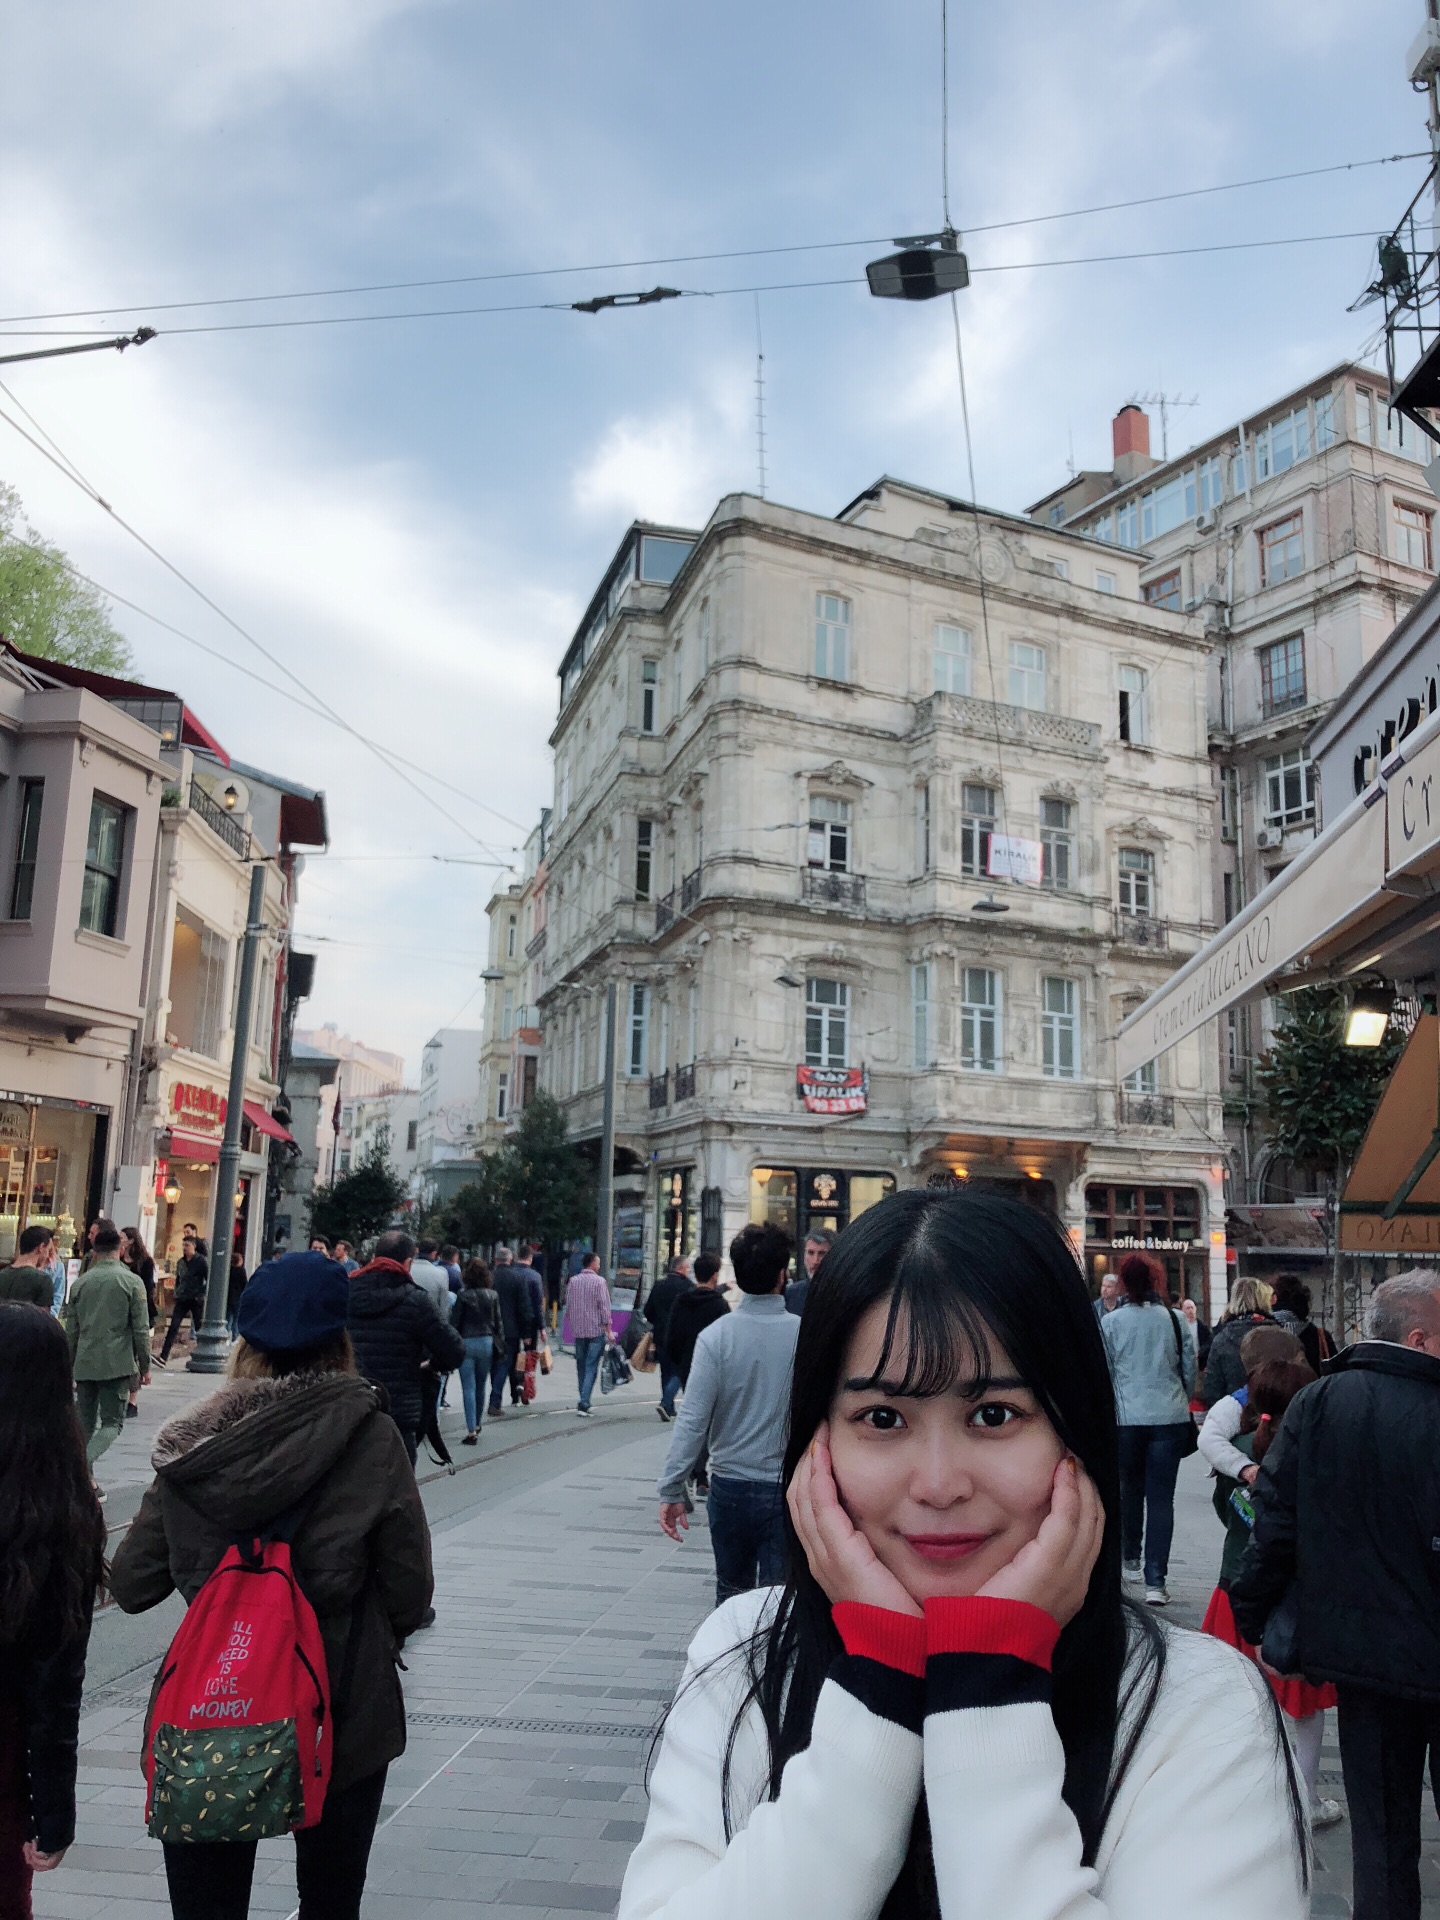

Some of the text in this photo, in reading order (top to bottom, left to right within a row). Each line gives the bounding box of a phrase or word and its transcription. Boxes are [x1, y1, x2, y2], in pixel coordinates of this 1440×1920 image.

[1111, 1235, 1189, 1253] coffee&bakery
[233, 1621, 252, 1634] ALL
[228, 1634, 252, 1647] OU
[217, 1647, 249, 1664] NEED
[219, 1661, 232, 1675] IS
[204, 1676, 238, 1696] LOVE
[189, 1697, 253, 1720] MONEY
